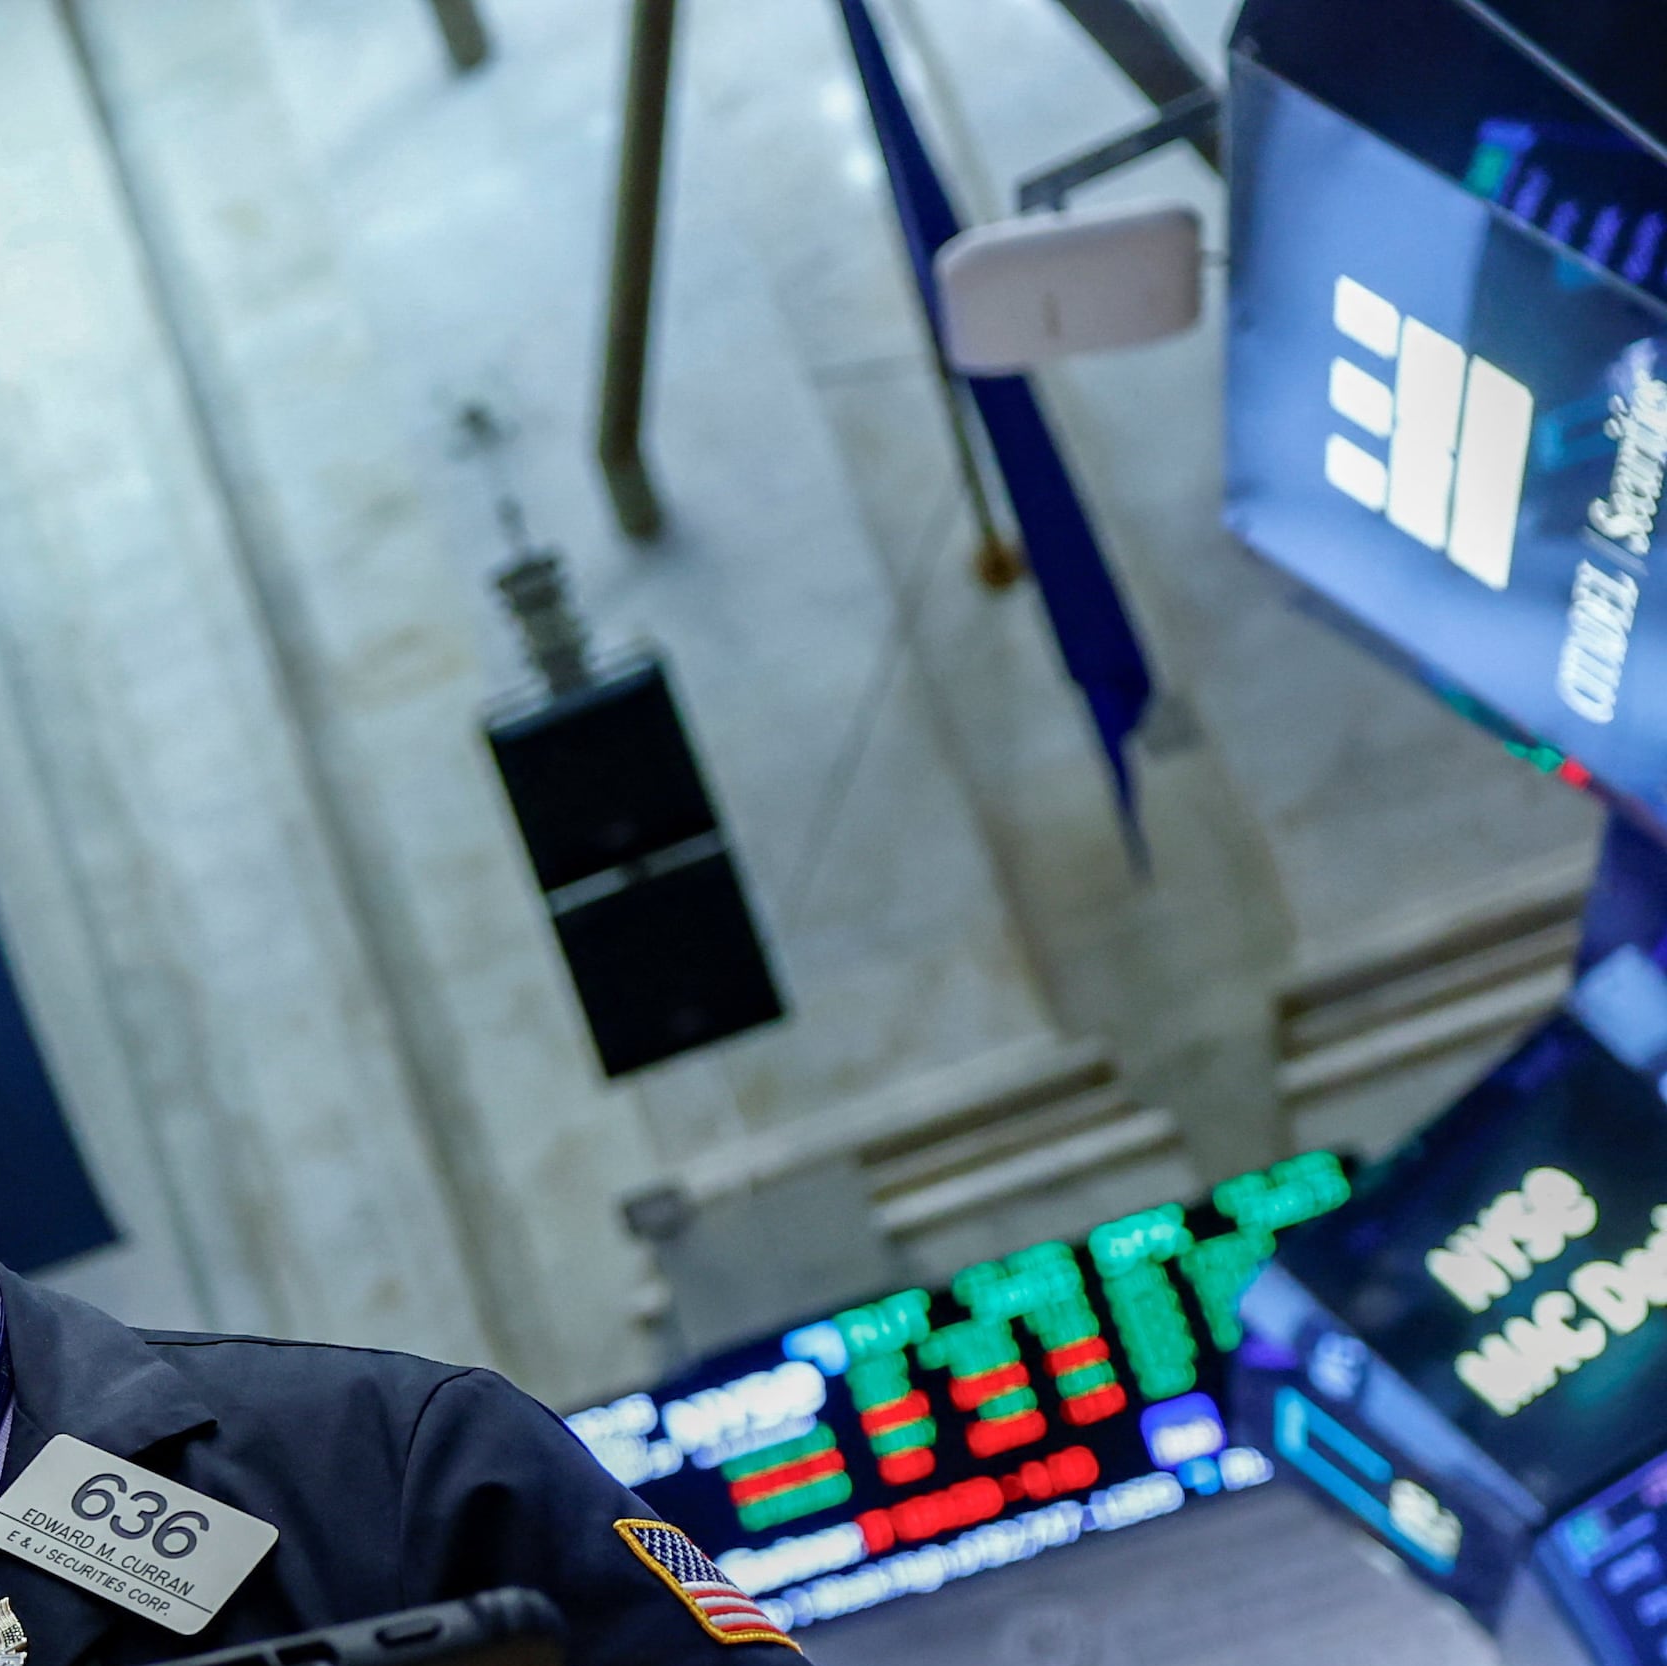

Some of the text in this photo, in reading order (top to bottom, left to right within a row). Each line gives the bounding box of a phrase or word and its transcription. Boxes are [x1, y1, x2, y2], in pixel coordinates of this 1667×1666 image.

[1454, 1290, 1607, 1417] MAC
[21, 1508, 196, 1596] EDWARD M. CURRAN
[71, 1473, 210, 1559] 636
[6, 1530, 171, 1616] E & J SECURITIES CORP.
